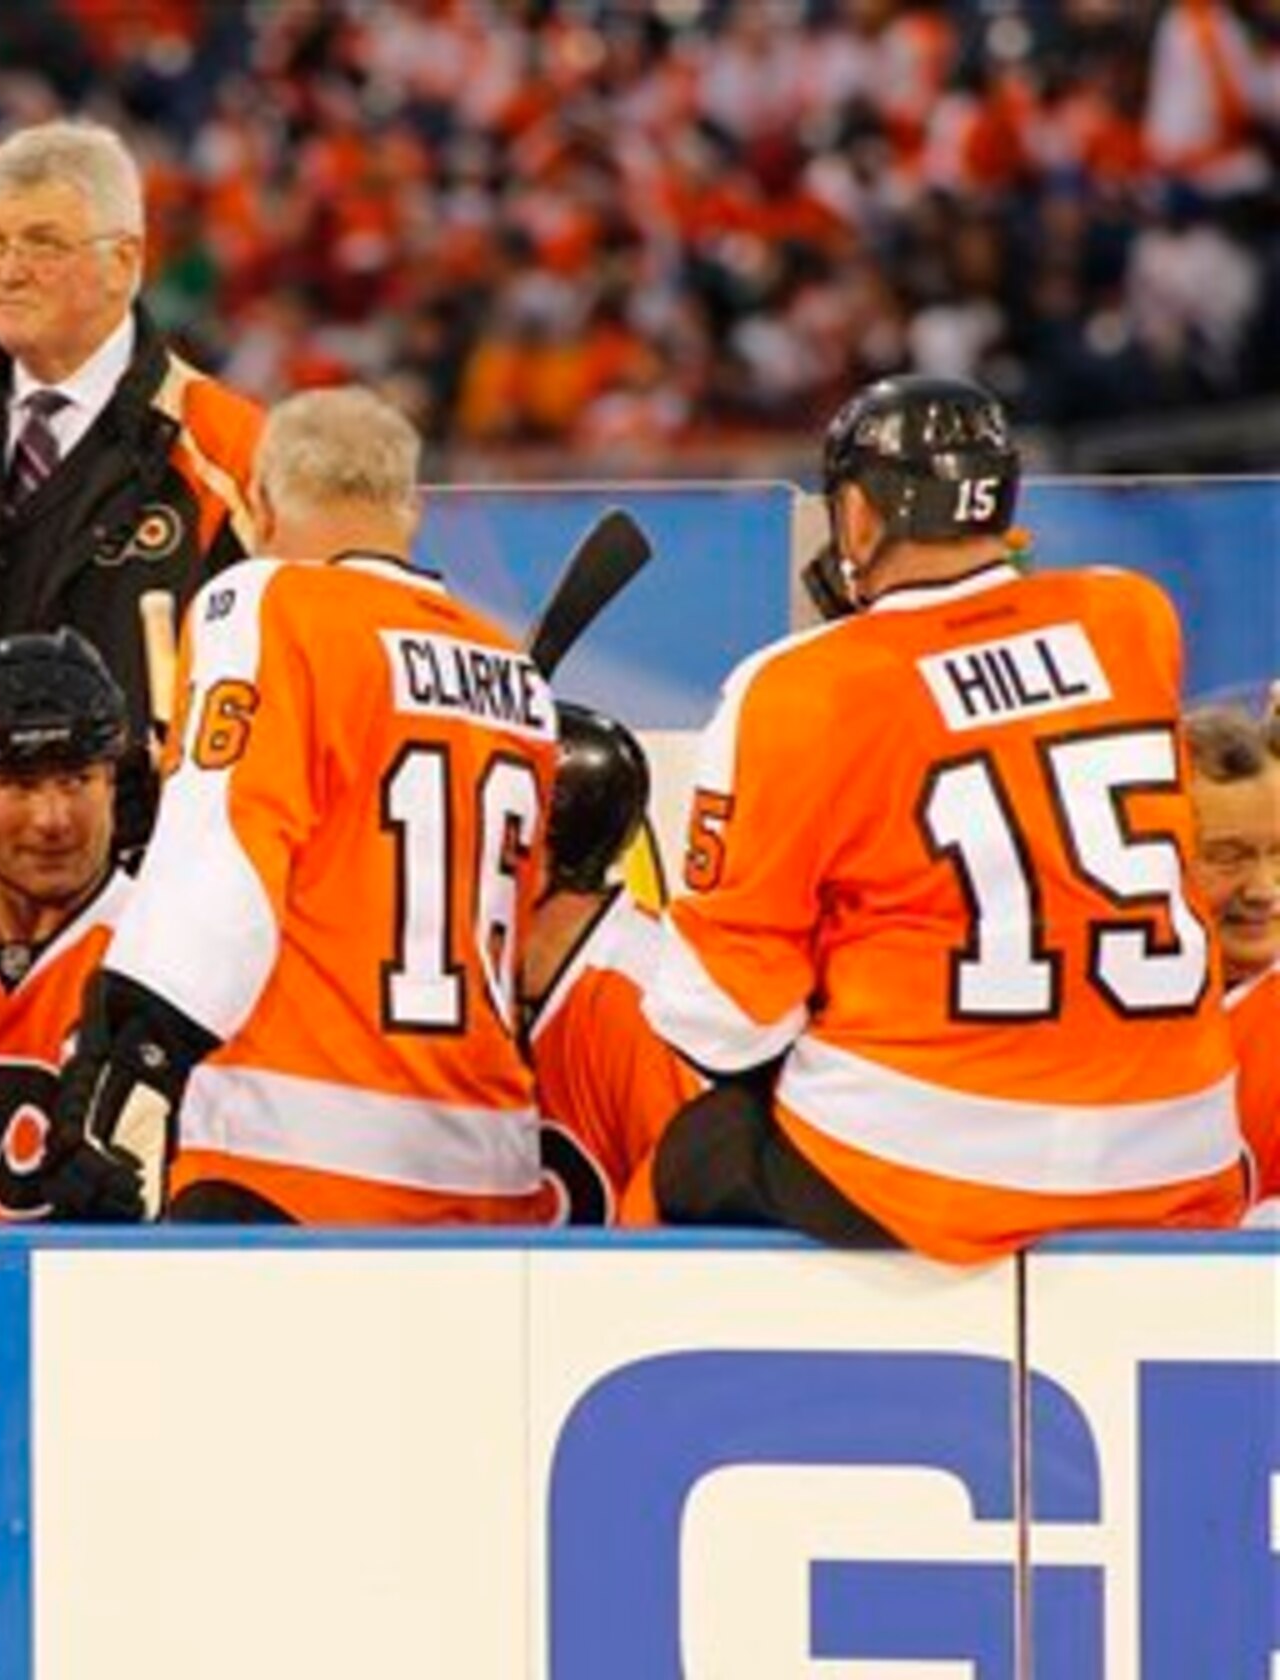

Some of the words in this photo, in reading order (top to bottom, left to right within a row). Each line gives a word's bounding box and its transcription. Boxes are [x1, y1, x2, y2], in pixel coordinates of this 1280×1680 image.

[953, 477, 1002, 523] 15
[399, 636, 546, 730] CLARKE
[944, 637, 1090, 717] HILL
[380, 739, 539, 1042] 16
[913, 719, 1211, 1025] 15
